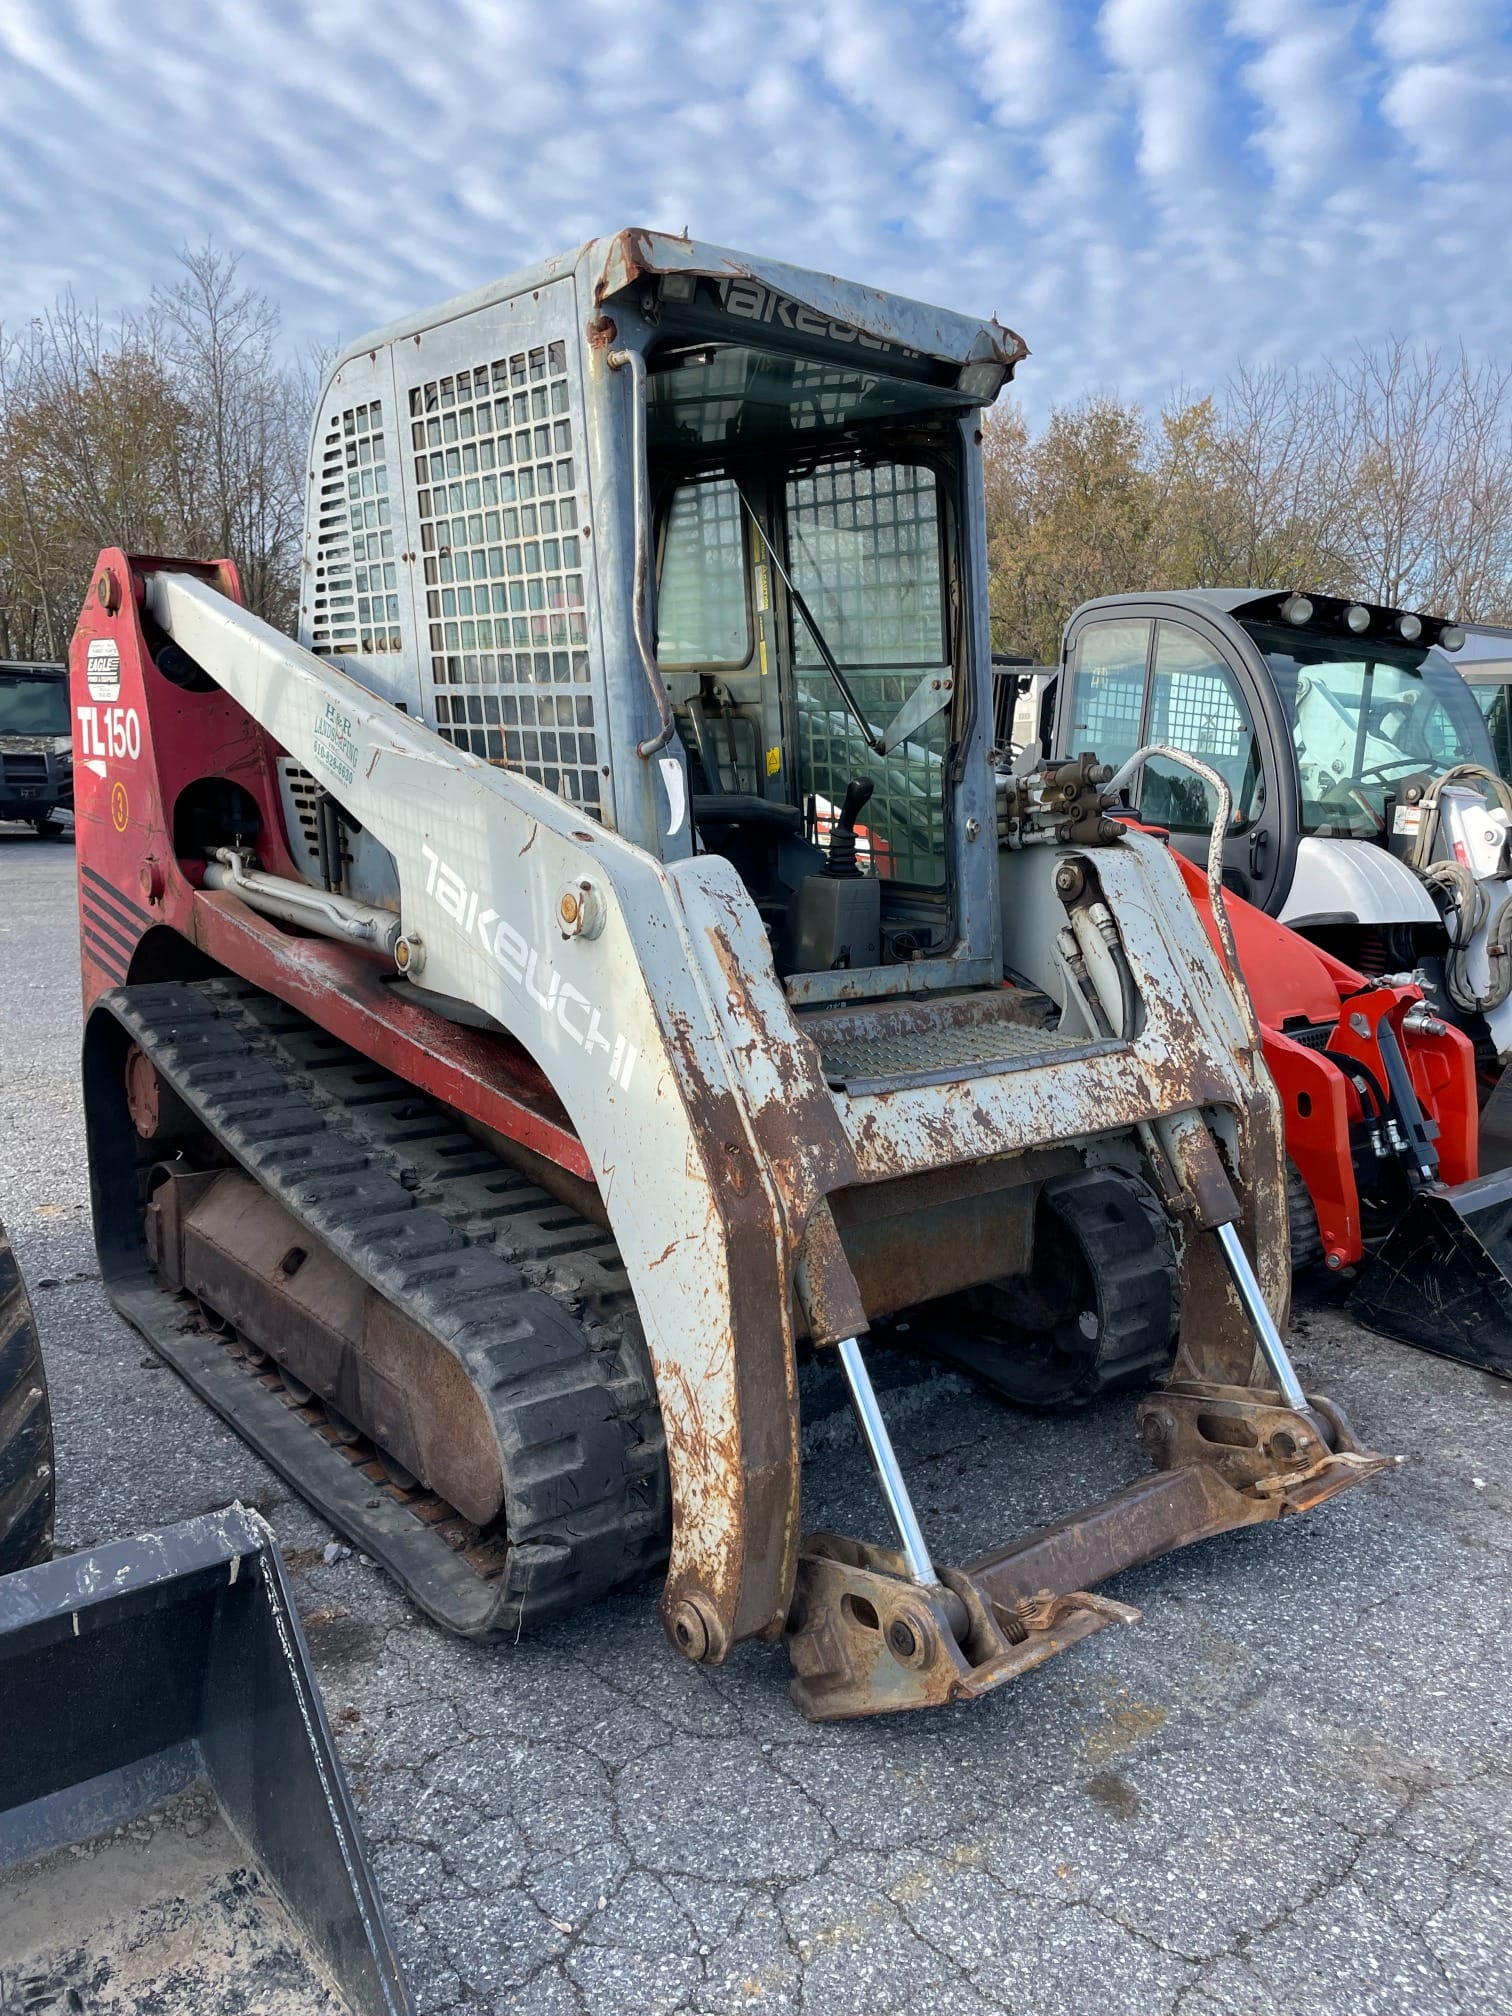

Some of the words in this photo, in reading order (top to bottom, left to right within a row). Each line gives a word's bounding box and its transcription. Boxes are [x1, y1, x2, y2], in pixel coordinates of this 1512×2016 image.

[87, 657, 120, 673] EAGLE
[77, 706, 141, 760] TL150
[116, 791, 124, 823] 3
